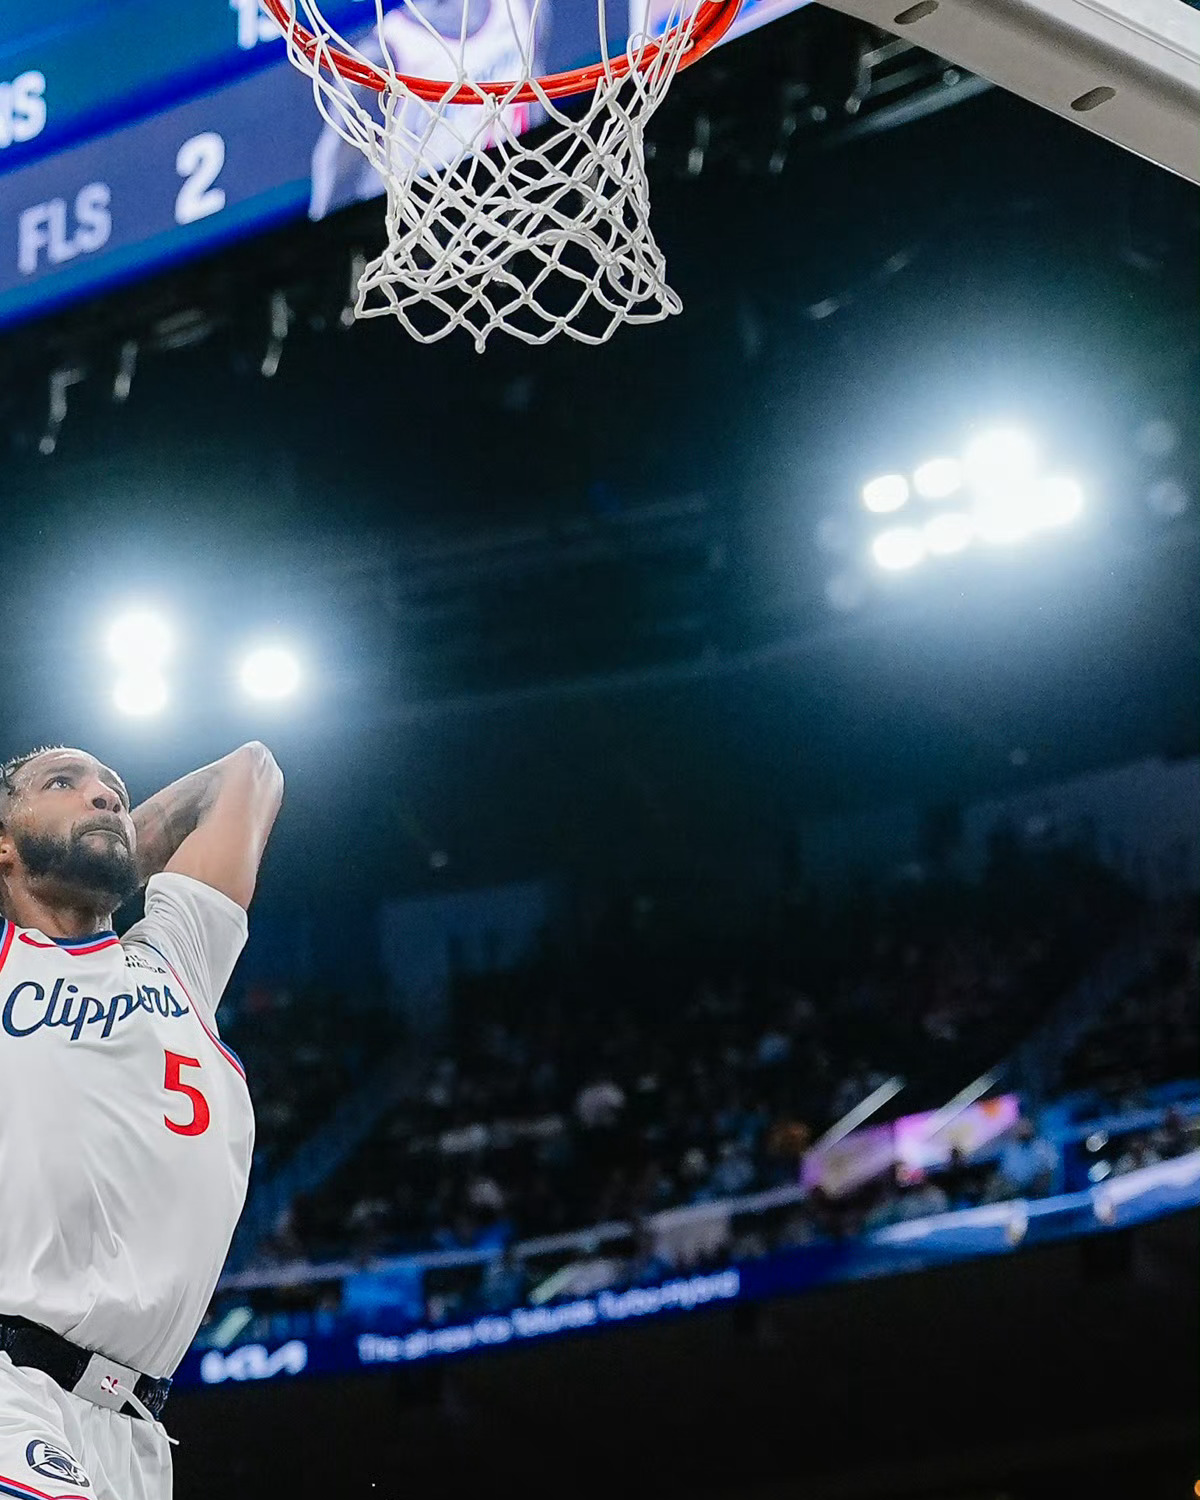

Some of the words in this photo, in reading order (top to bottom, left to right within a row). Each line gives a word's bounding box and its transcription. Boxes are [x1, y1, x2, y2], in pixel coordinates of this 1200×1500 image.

[175, 131, 226, 225] 2
[17, 182, 112, 275] FLS
[2, 978, 190, 1041] Clippers
[163, 1049, 211, 1137] 5
